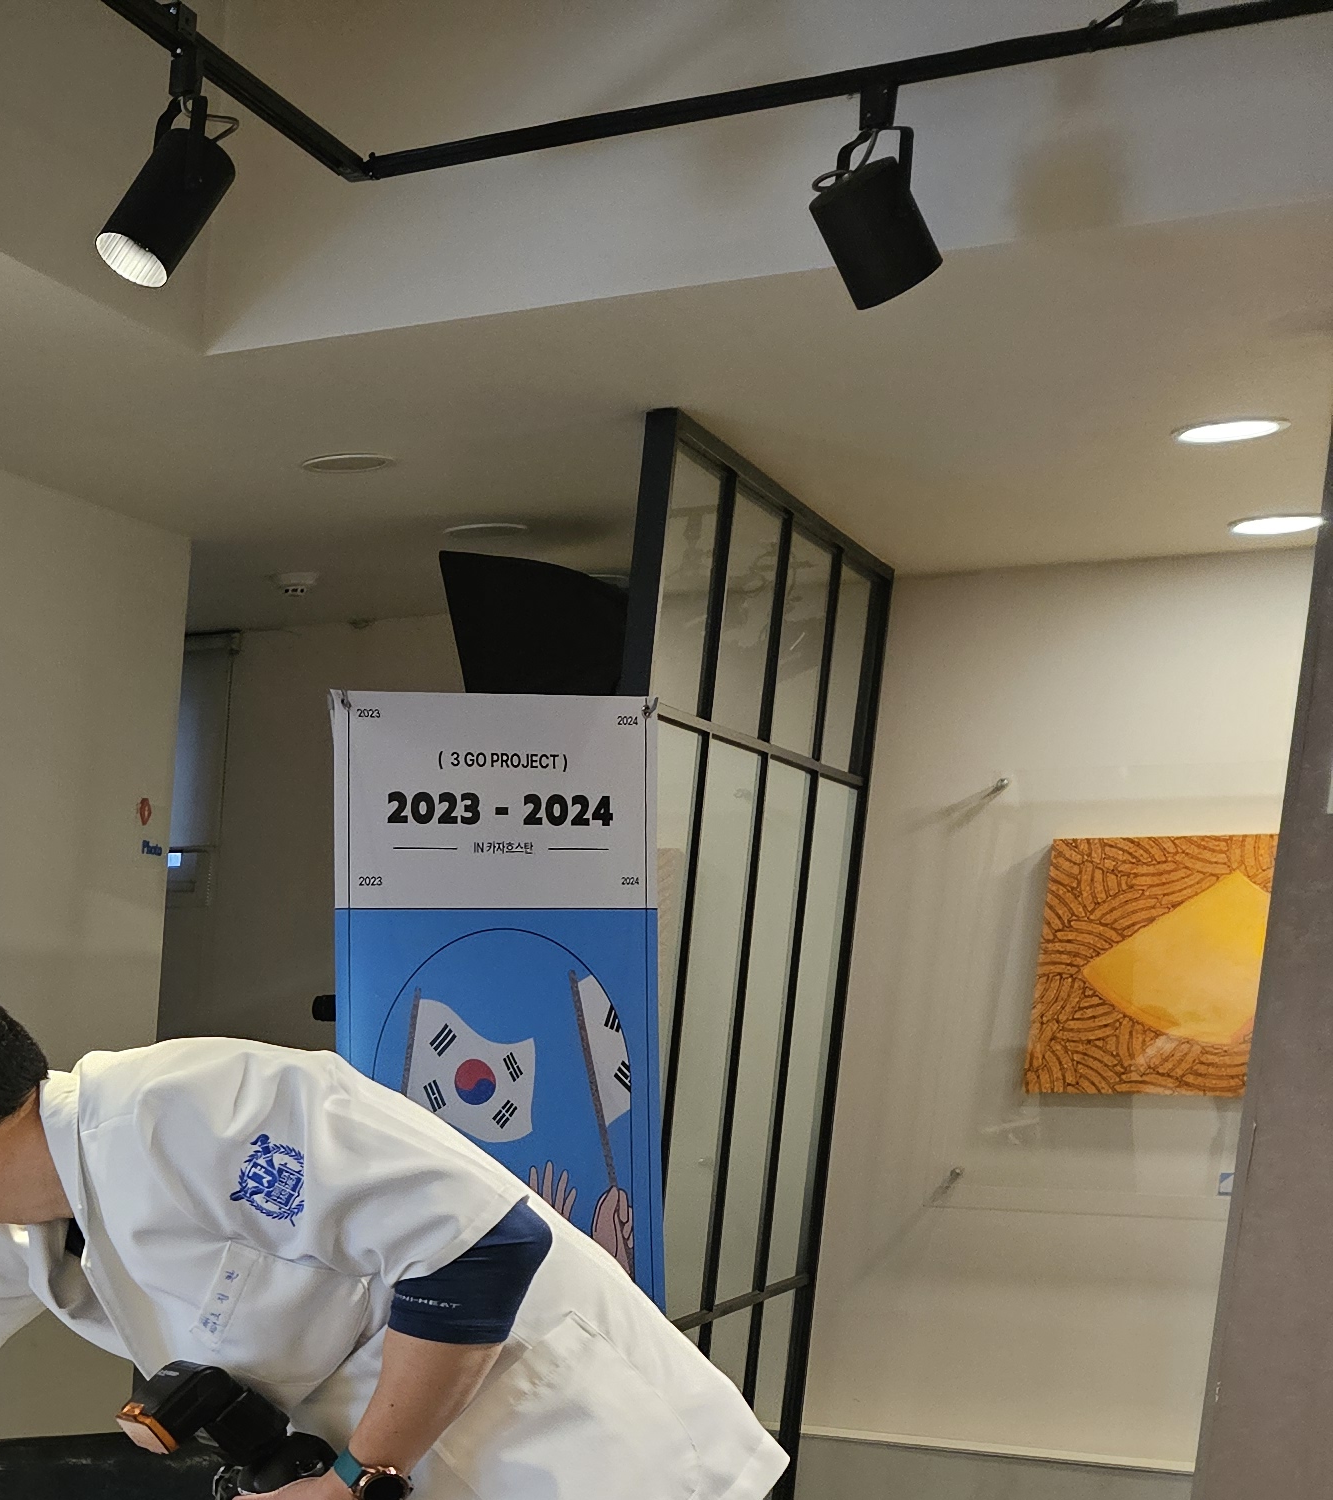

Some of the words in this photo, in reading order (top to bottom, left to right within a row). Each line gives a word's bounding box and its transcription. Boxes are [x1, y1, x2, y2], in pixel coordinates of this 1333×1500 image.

[356, 708, 381, 719] 2023
[617, 715, 639, 727] 2024
[464, 752, 487, 768] GO
[490, 753, 560, 770] PROJECT
[387, 791, 481, 825] 2023
[523, 793, 614, 826] 2024
[473, 841, 485, 854] IN
[486, 841, 534, 855] 카자흐스탄
[358, 876, 383, 886] 2023
[621, 876, 640, 886] 2024
